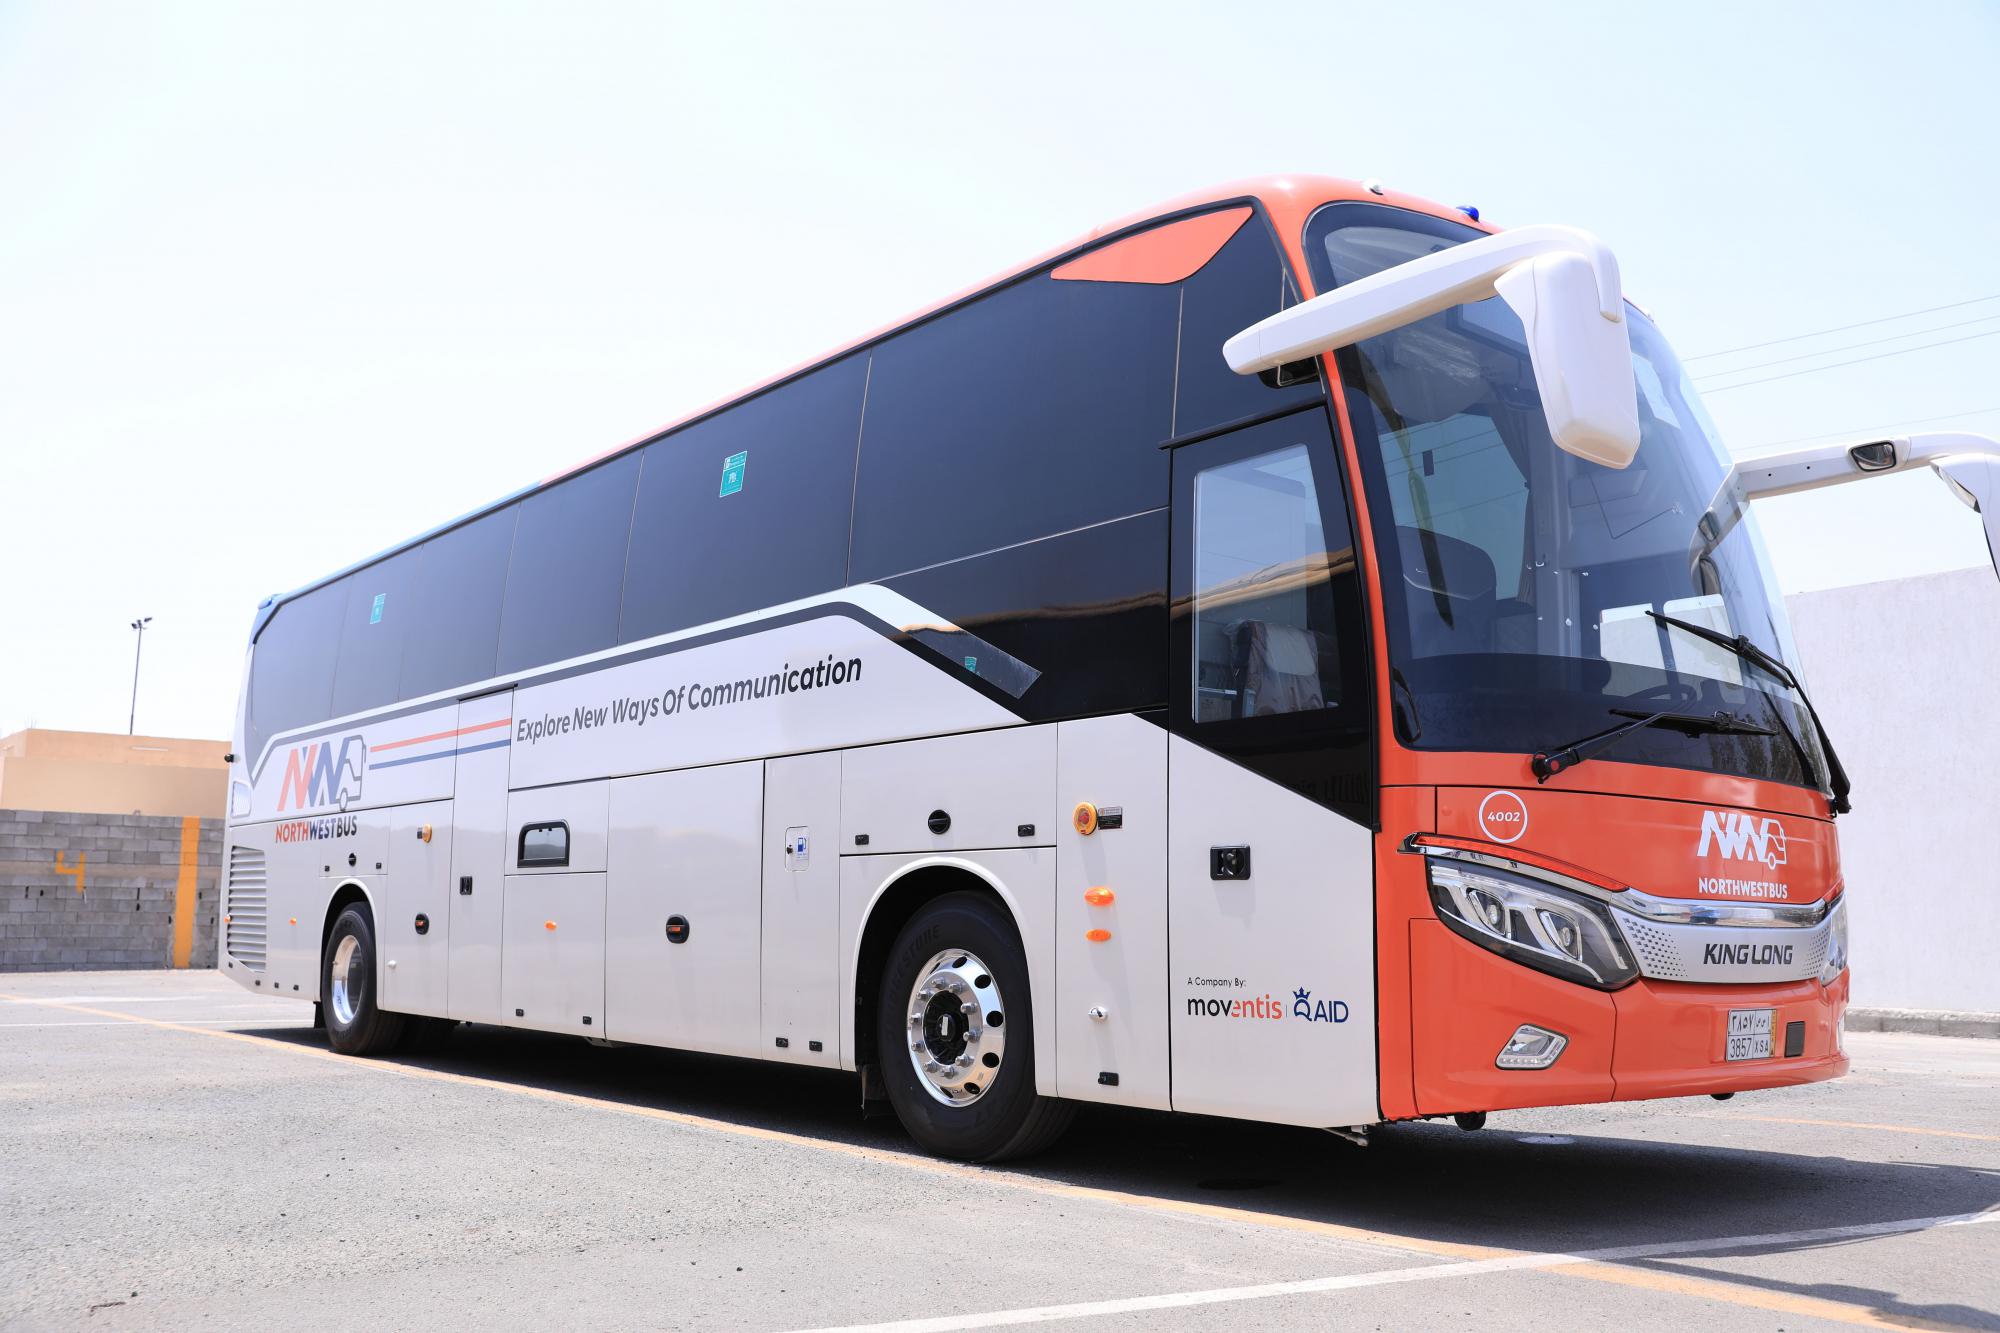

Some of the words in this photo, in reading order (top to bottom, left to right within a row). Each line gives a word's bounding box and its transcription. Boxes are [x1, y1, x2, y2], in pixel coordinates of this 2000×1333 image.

[515, 713, 571, 744] Explore
[572, 705, 608, 732] New
[612, 696, 659, 727] Ways
[662, 685, 686, 716] Of
[687, 654, 862, 710] Communication
[1487, 811, 1521, 823] 4002
[1187, 977, 1193, 986] A
[1195, 977, 1232, 988] Company
[1234, 977, 1246, 988] By:
[1187, 994, 1283, 1020] moventis
[1293, 998, 1349, 1023] QAID
[1730, 1037, 1752, 1058] 3857
